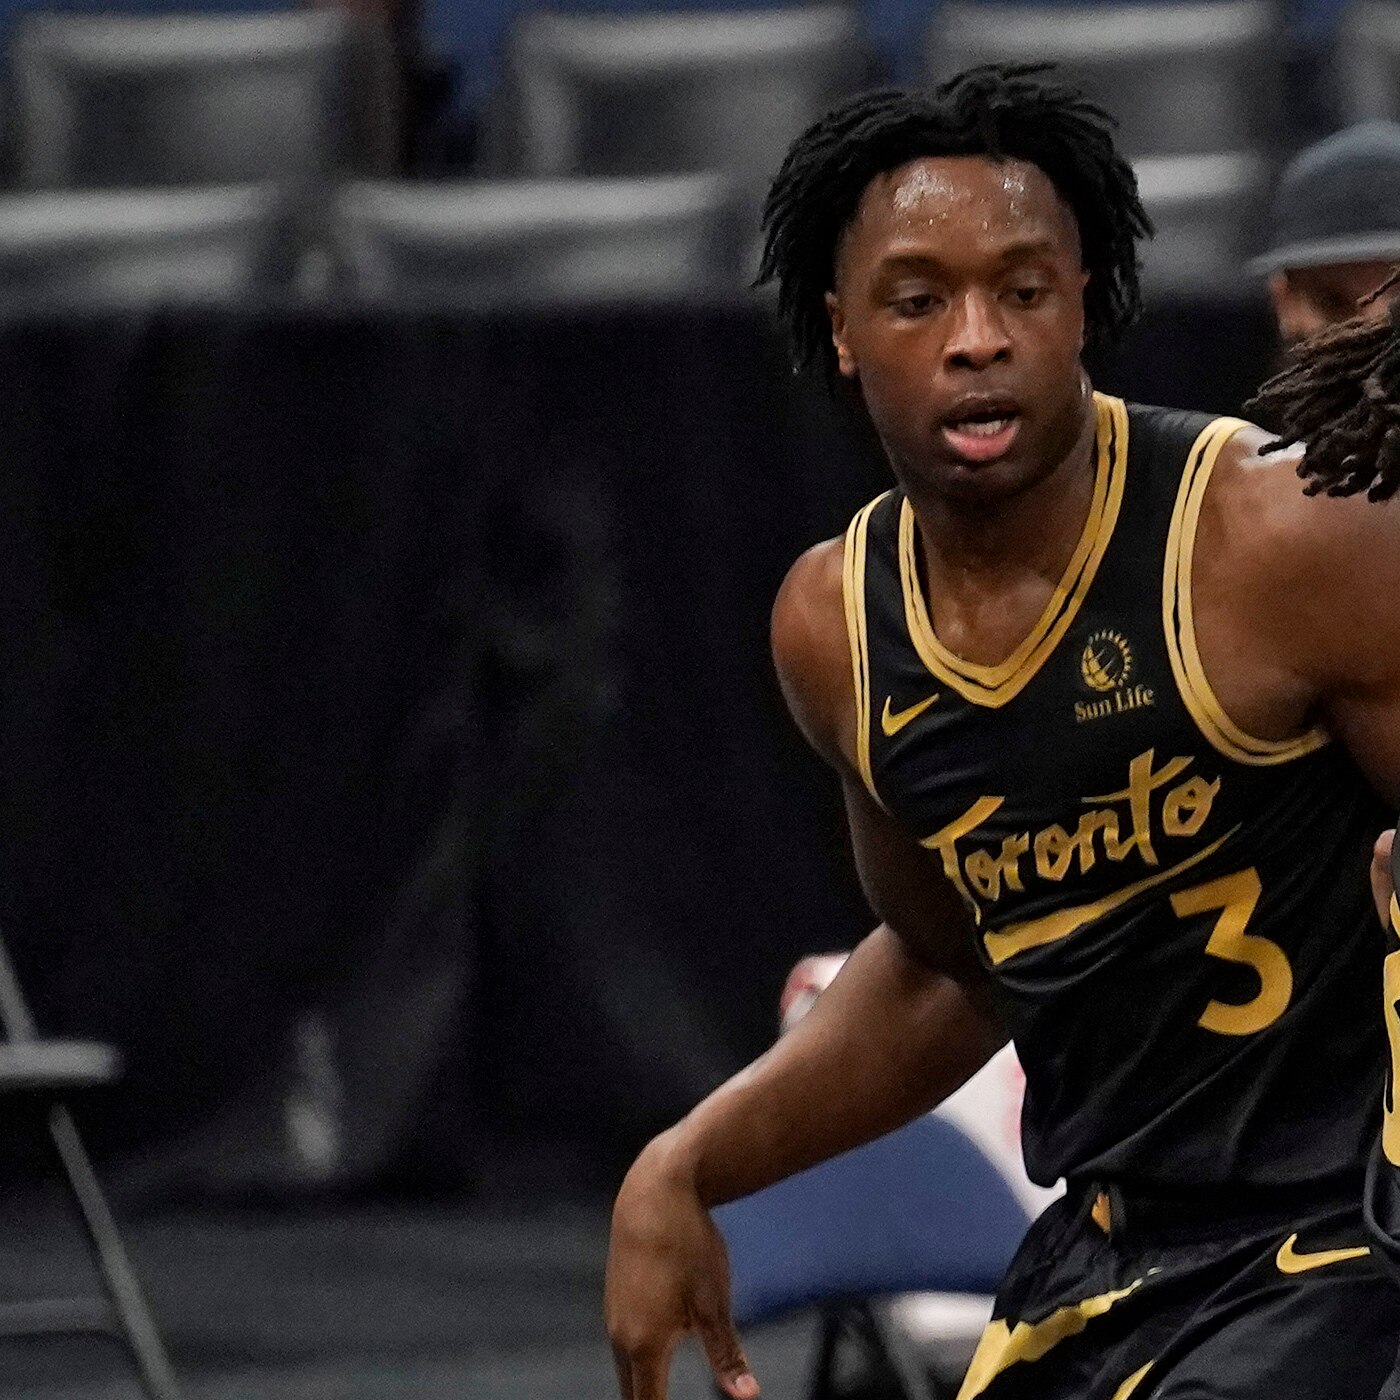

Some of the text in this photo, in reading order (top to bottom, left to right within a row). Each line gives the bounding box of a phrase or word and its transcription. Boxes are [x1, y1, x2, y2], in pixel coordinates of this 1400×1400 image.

[1074, 683, 1154, 723] Sun Life
[919, 746, 1222, 926] Toronto
[1168, 865, 1294, 1037] 3
